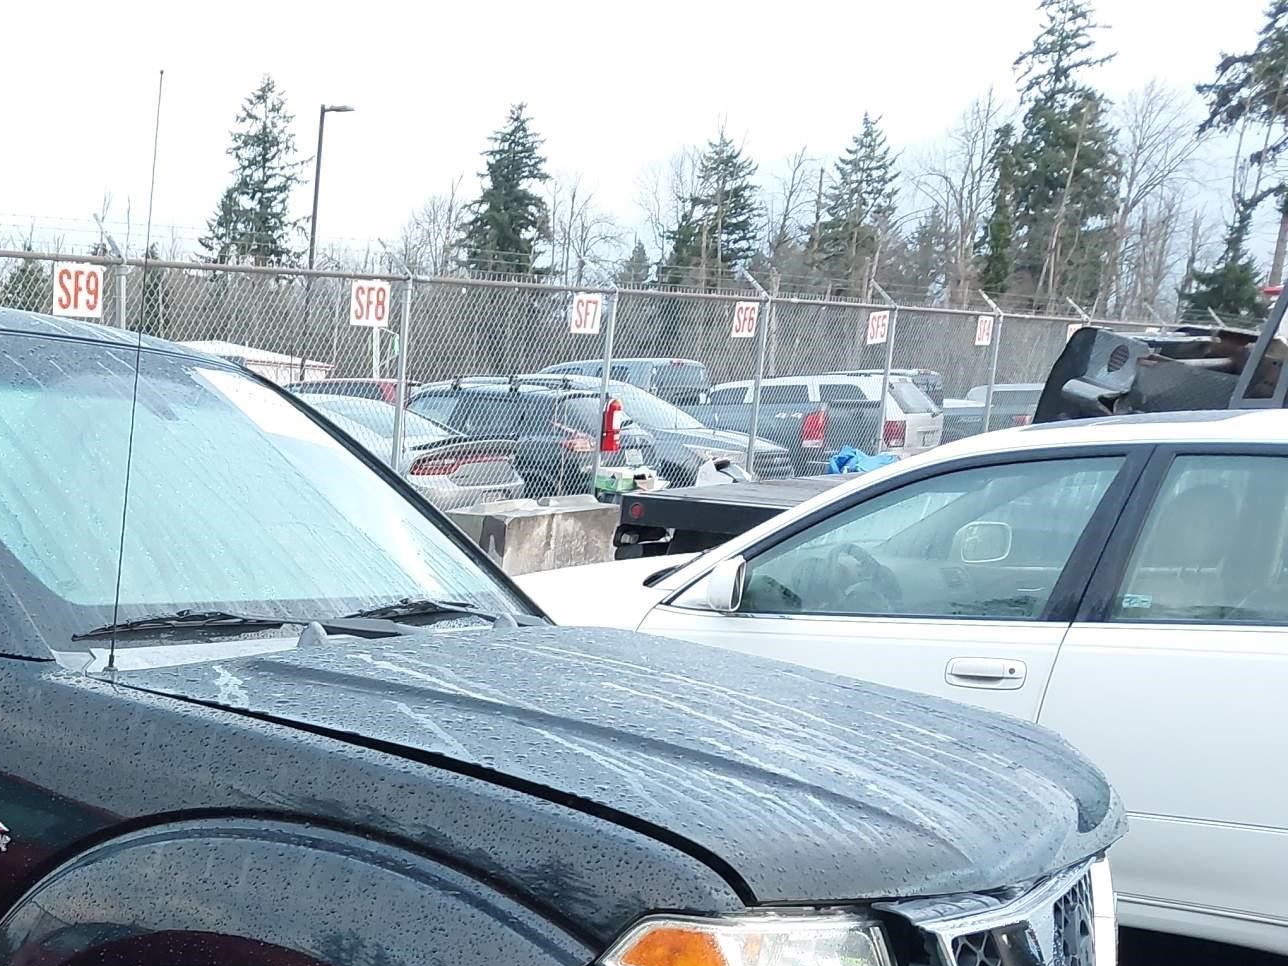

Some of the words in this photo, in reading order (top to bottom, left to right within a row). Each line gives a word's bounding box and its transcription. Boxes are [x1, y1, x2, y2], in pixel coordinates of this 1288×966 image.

[57, 268, 100, 312] SF9
[354, 285, 387, 321] SF8
[574, 298, 599, 329] SF7
[733, 305, 757, 335] SF6
[868, 312, 888, 341] SF5
